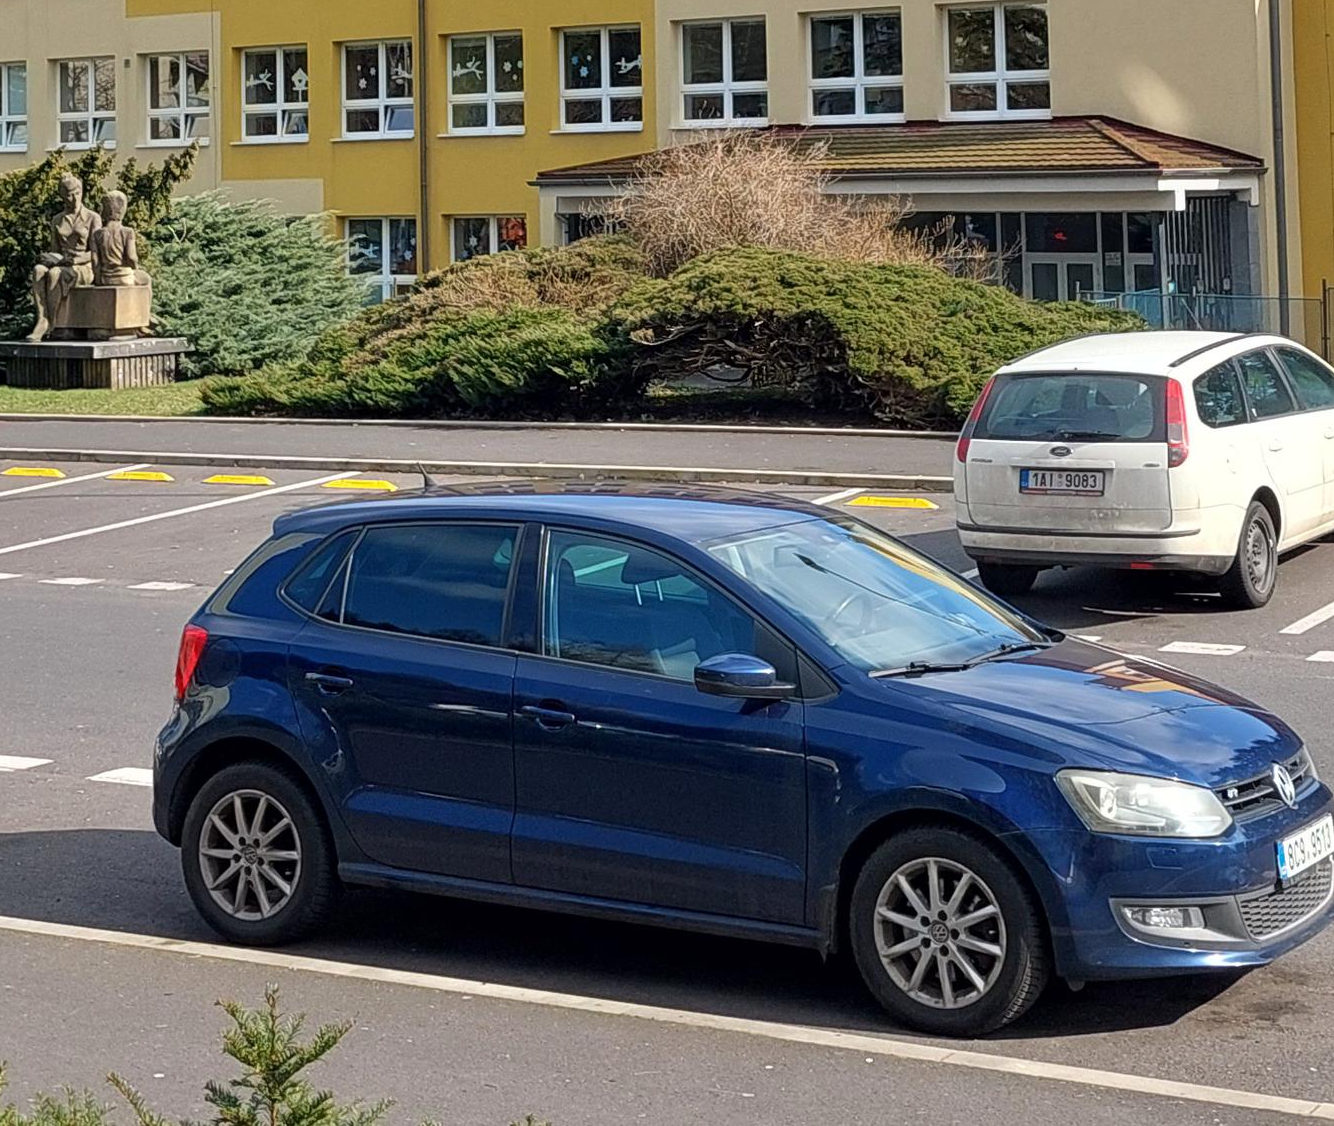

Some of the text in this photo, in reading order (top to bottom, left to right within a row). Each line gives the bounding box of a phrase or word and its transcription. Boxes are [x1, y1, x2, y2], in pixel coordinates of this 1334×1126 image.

[1032, 472, 1098, 489] 1AI 9083
[1288, 823, 1332, 870] 8C9 9513
